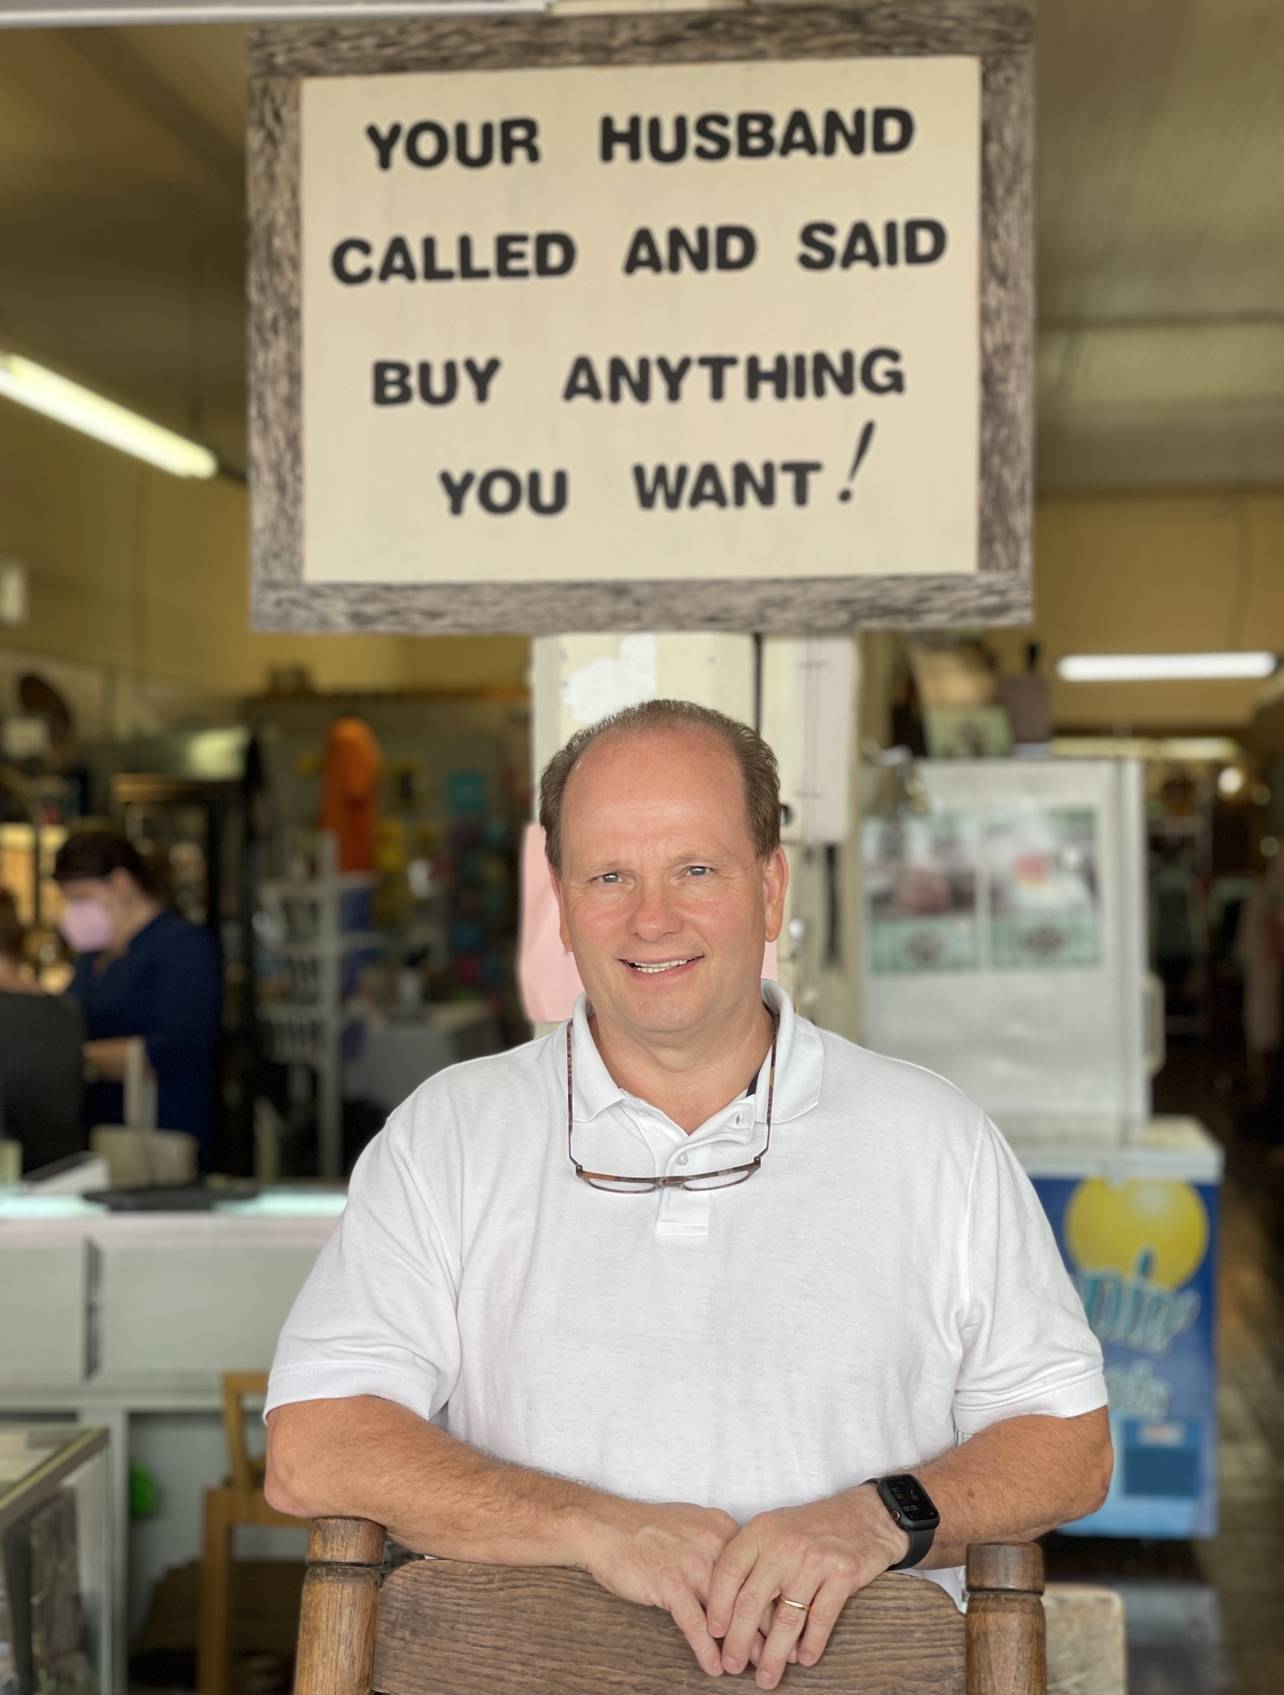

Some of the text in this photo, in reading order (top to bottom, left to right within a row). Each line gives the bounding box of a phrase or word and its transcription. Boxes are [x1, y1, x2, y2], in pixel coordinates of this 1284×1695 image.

[365, 107, 915, 170] YOUR HUSBAND
[331, 219, 947, 286] CALLED AND SAID
[372, 347, 905, 407] BUY ANYTHING
[439, 420, 876, 516] YOU WANT!
